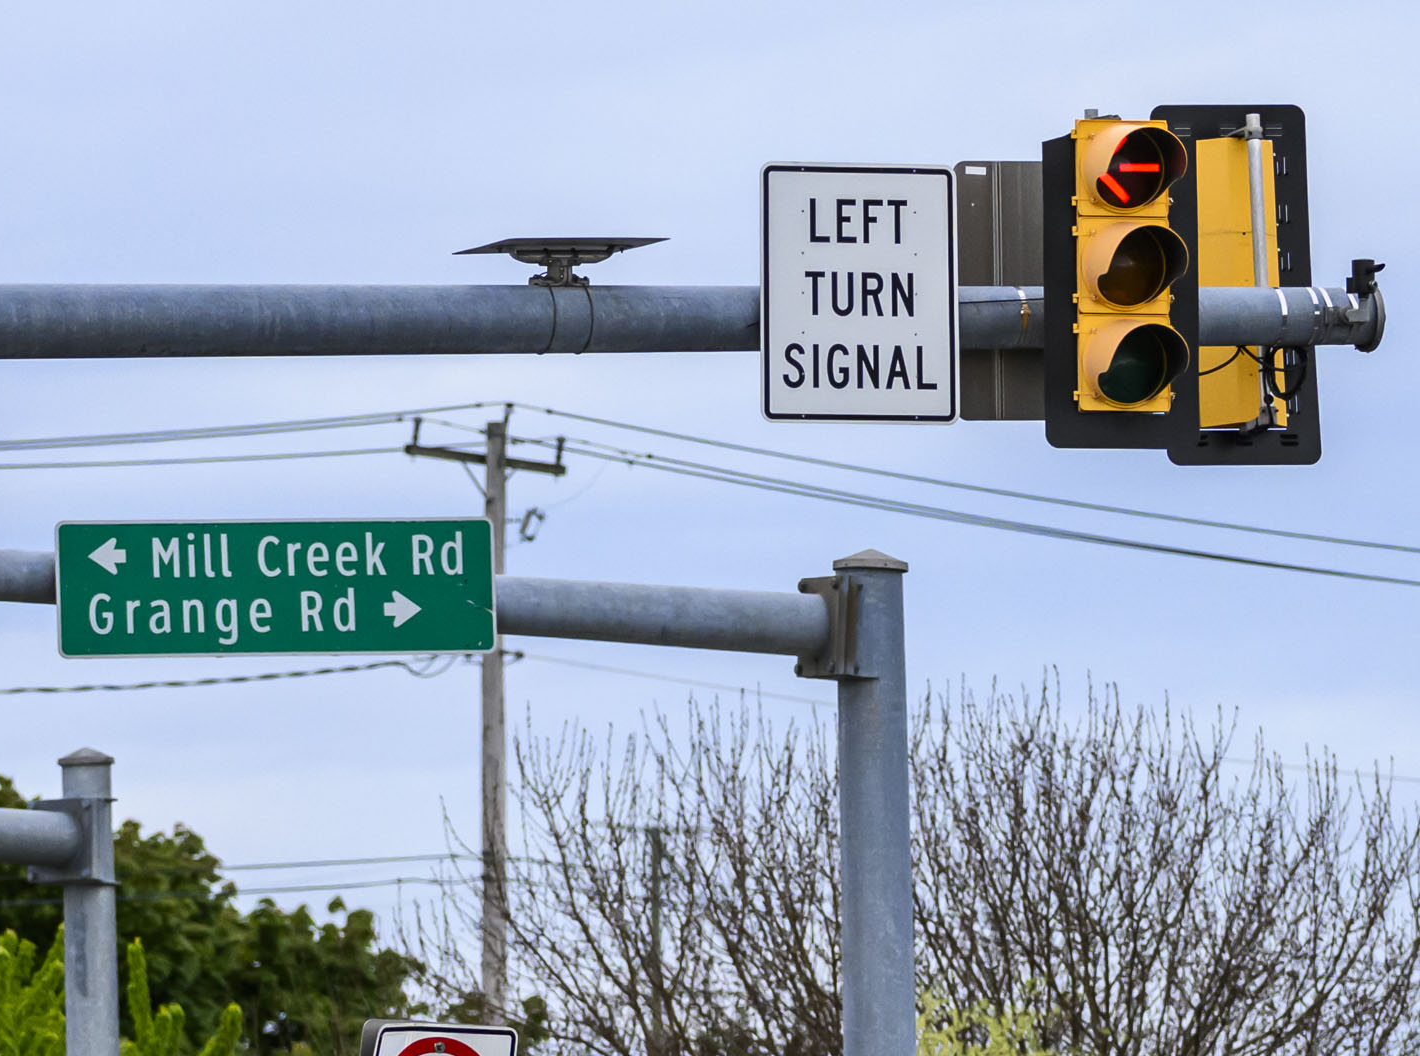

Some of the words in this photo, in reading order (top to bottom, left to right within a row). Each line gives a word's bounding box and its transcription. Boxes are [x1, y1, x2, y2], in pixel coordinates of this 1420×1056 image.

[809, 198, 908, 244] LEFT
[805, 271, 914, 317] TURN
[783, 343, 938, 390] SIGNAL
[151, 532, 233, 578] Mill
[257, 532, 387, 577] Creek
[411, 531, 464, 576] Rd
[88, 592, 273, 645] Grange
[300, 587, 356, 632] Rd
